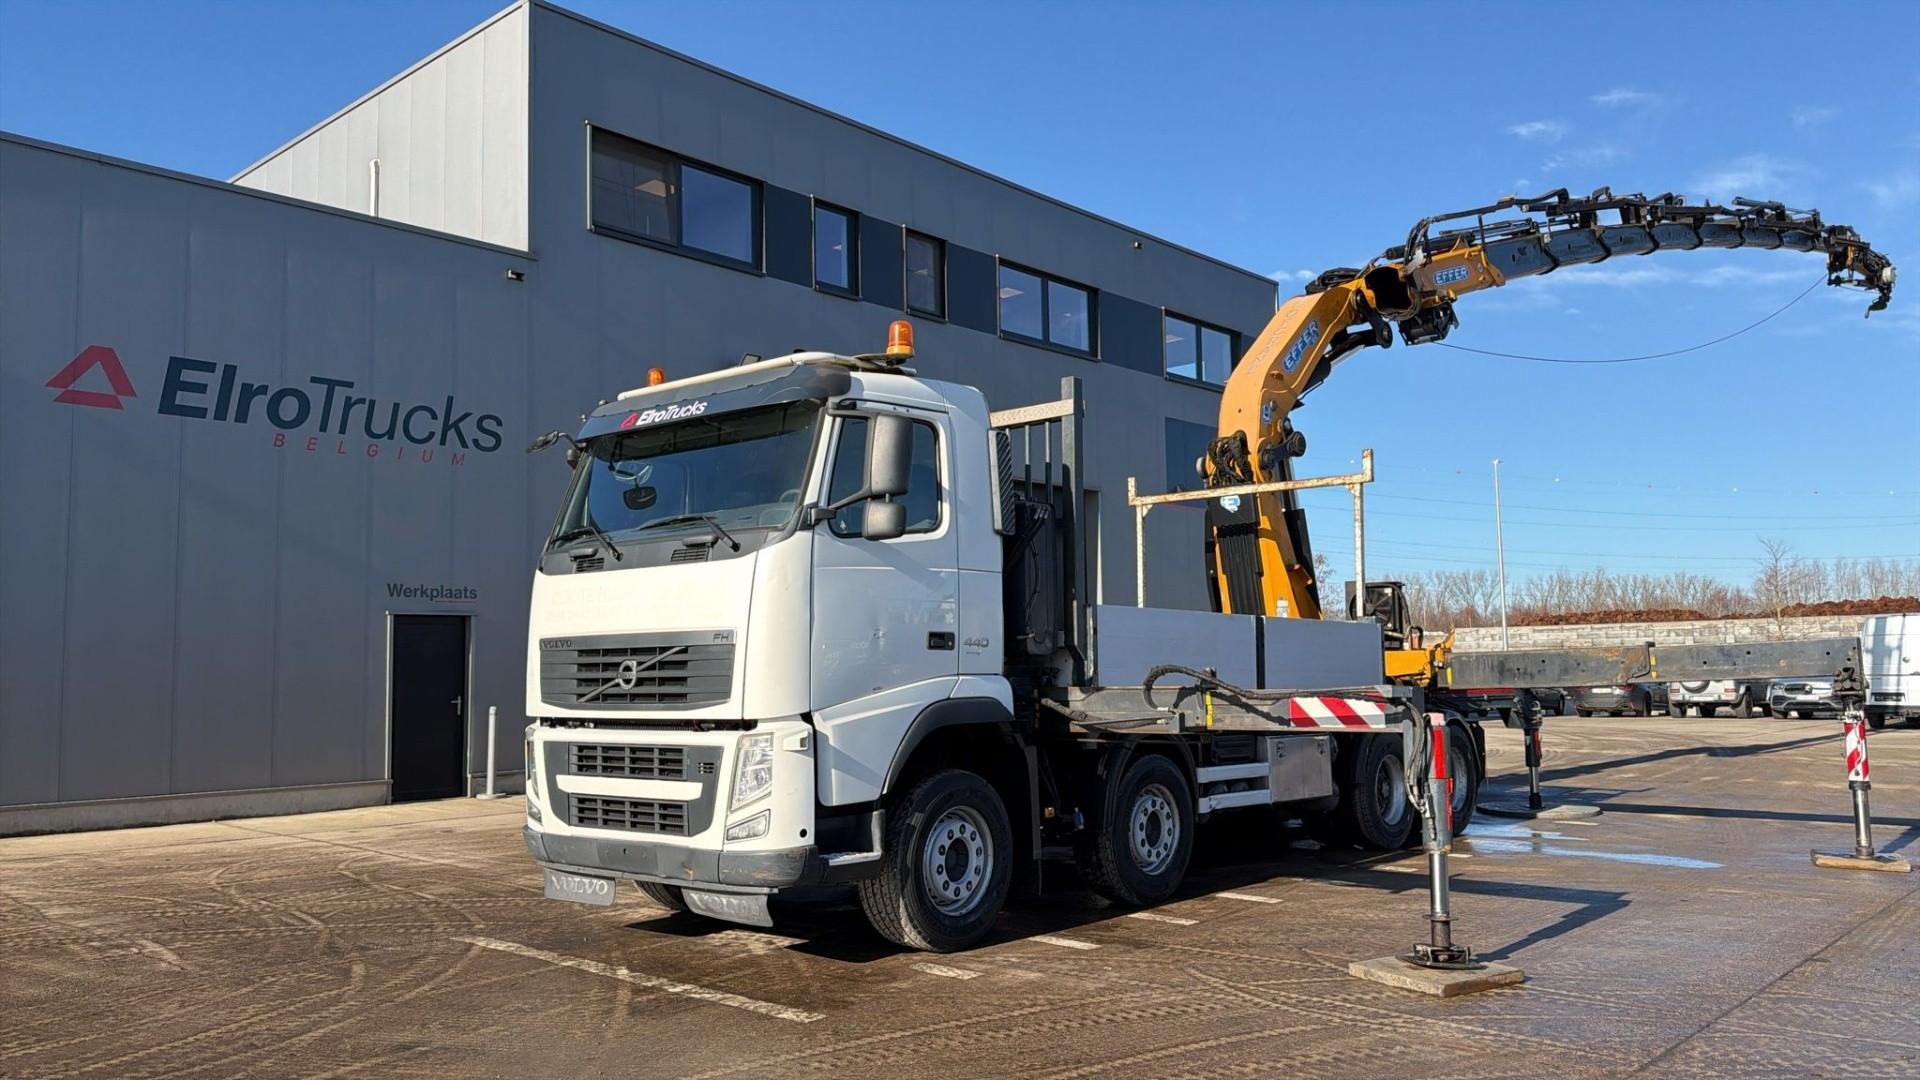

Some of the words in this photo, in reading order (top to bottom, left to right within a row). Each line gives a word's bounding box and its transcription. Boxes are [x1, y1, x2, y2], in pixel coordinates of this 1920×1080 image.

[1435, 267, 1467, 284] EFFER
[1284, 320, 1319, 370] EFFER
[158, 356, 503, 453] ElroTrucks
[636, 401, 707, 426] ElroTrucks
[273, 433, 466, 466] BELGIUM
[387, 583, 478, 601] Werkplaats
[542, 639, 572, 649] VOLVO
[713, 634, 729, 643] FH
[963, 637, 989, 648] 440
[551, 875, 608, 896] VOLVO
